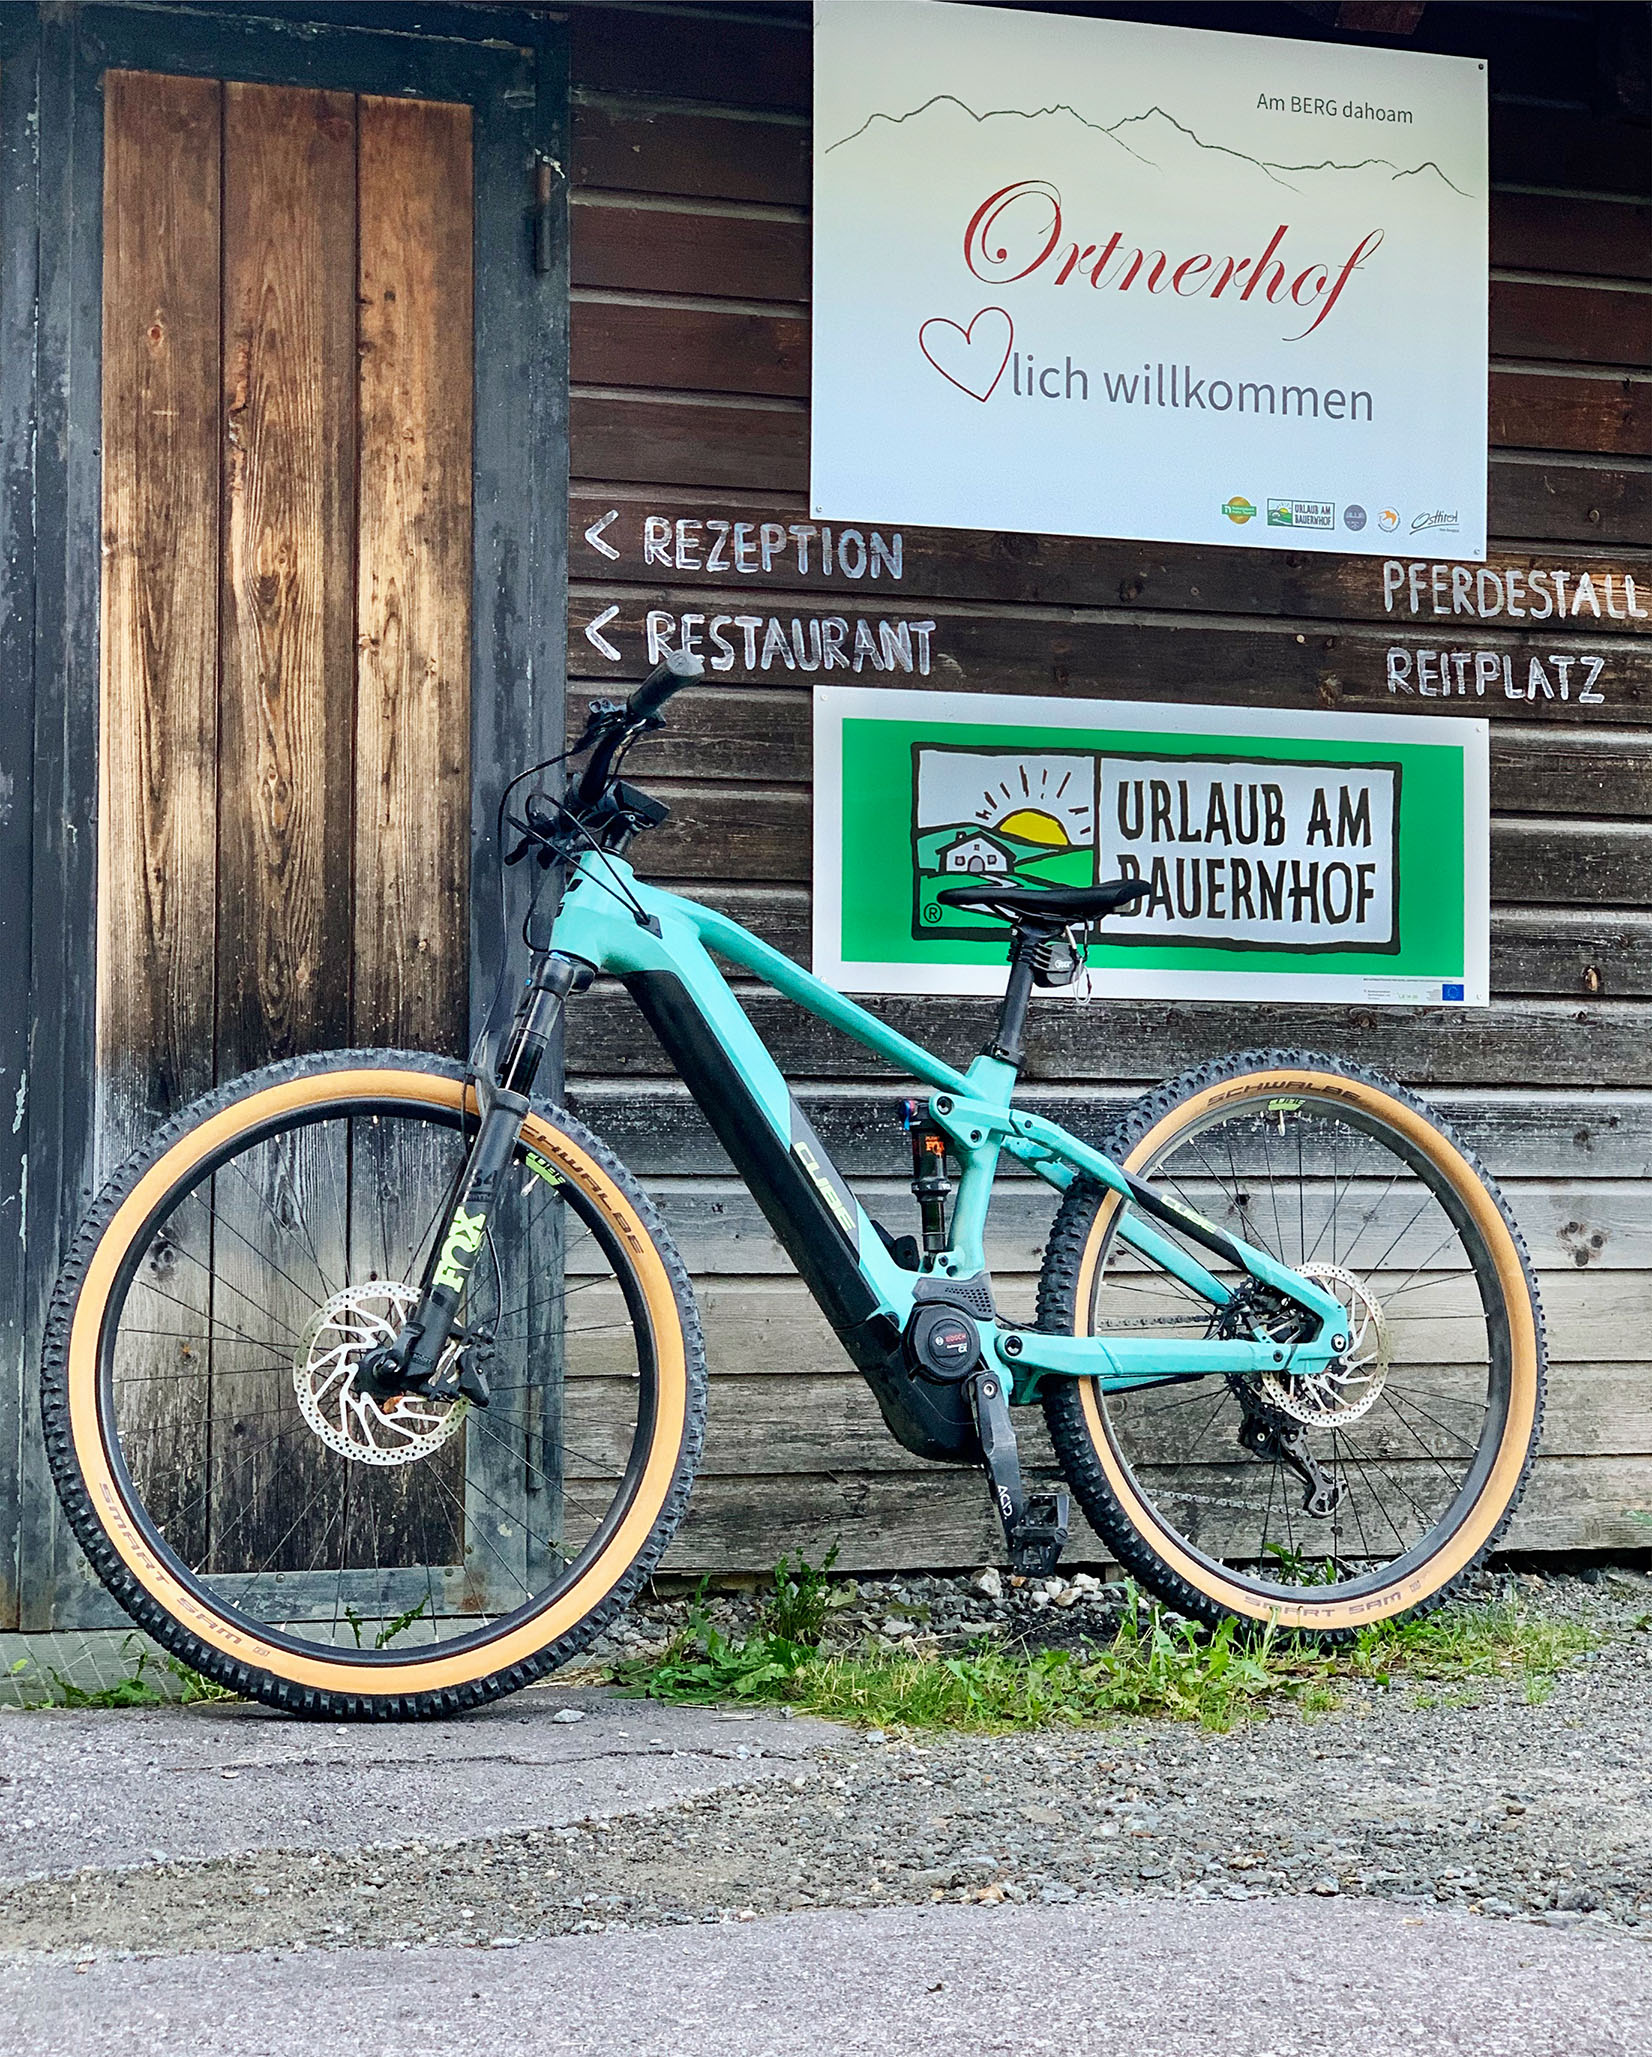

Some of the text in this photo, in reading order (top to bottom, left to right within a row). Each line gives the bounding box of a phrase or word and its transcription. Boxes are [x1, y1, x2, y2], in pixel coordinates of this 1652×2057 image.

[1257, 93, 1413, 124] Am BERG dahoam
[963, 179, 1385, 342] Ortnerhof
[1012, 351, 1374, 422] lich willkommen
[1294, 504, 1331, 515] URLAUB AM
[1294, 514, 1332, 526] BAUERNHOF
[644, 516, 903, 580] REZEPTION
[1383, 560, 1649, 619] PFERDESTALL
[646, 610, 936, 676] RESTAURANT
[1386, 647, 1605, 704] REITPLATZ
[1116, 779, 1372, 848] URLAUB AM
[1115, 854, 1376, 925] BAUERNHOF
[1207, 1080, 1361, 1107] SCHWALBE
[519, 1122, 645, 1255] CHWALBE
[793, 1141, 857, 1232] CUBE
[432, 1206, 487, 1294] FOX
[99, 1482, 243, 1645] SMART SAM
[1348, 1591, 1401, 1615] SAM
